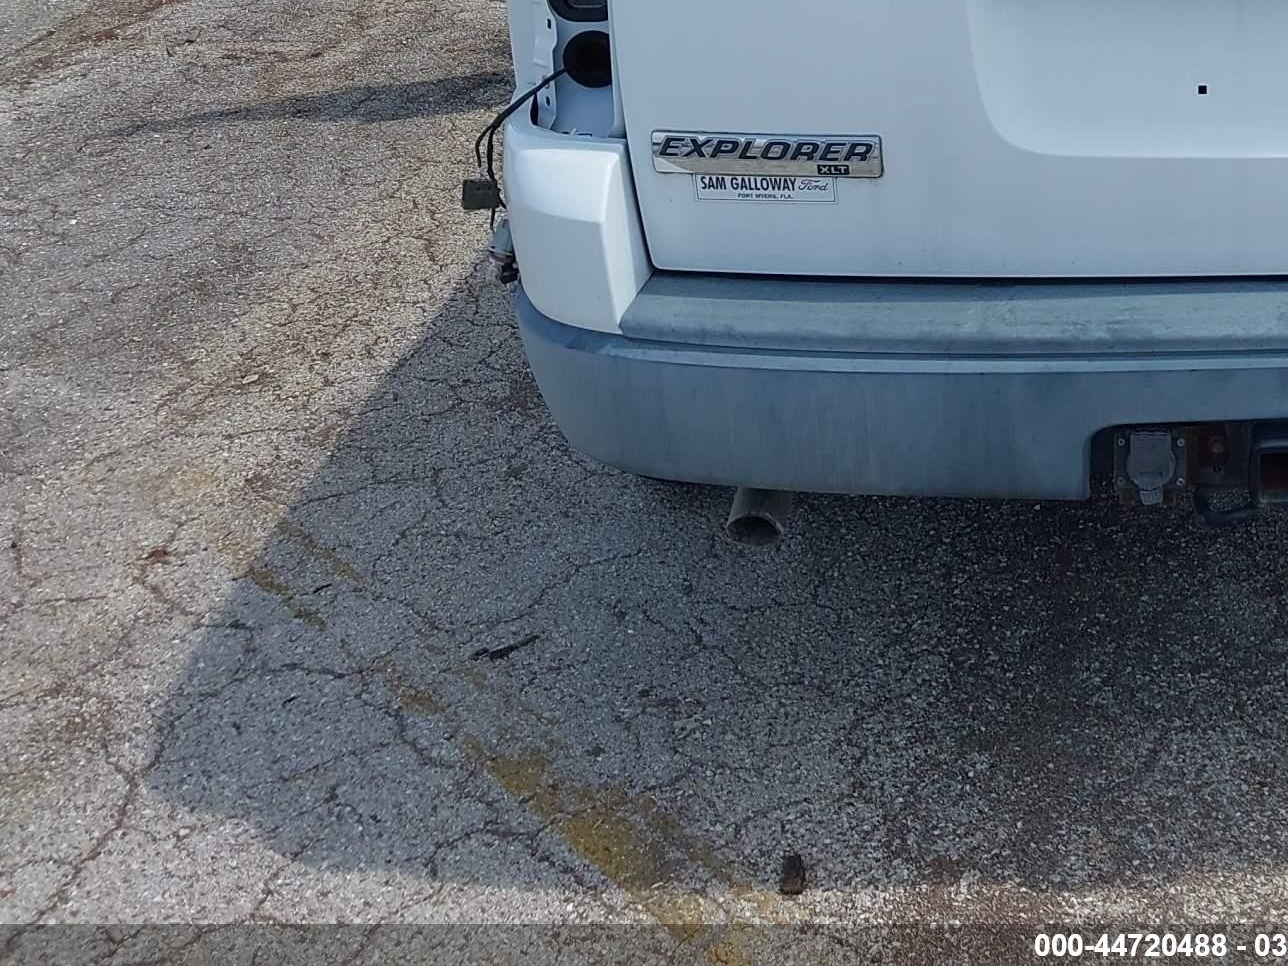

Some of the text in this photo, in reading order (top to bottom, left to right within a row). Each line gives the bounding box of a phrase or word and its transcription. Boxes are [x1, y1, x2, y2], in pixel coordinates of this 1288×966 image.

[659, 136, 873, 161] EXPLORER
[820, 166, 847, 174] XLT
[700, 176, 829, 192] SAM GALLOWAY Ford
